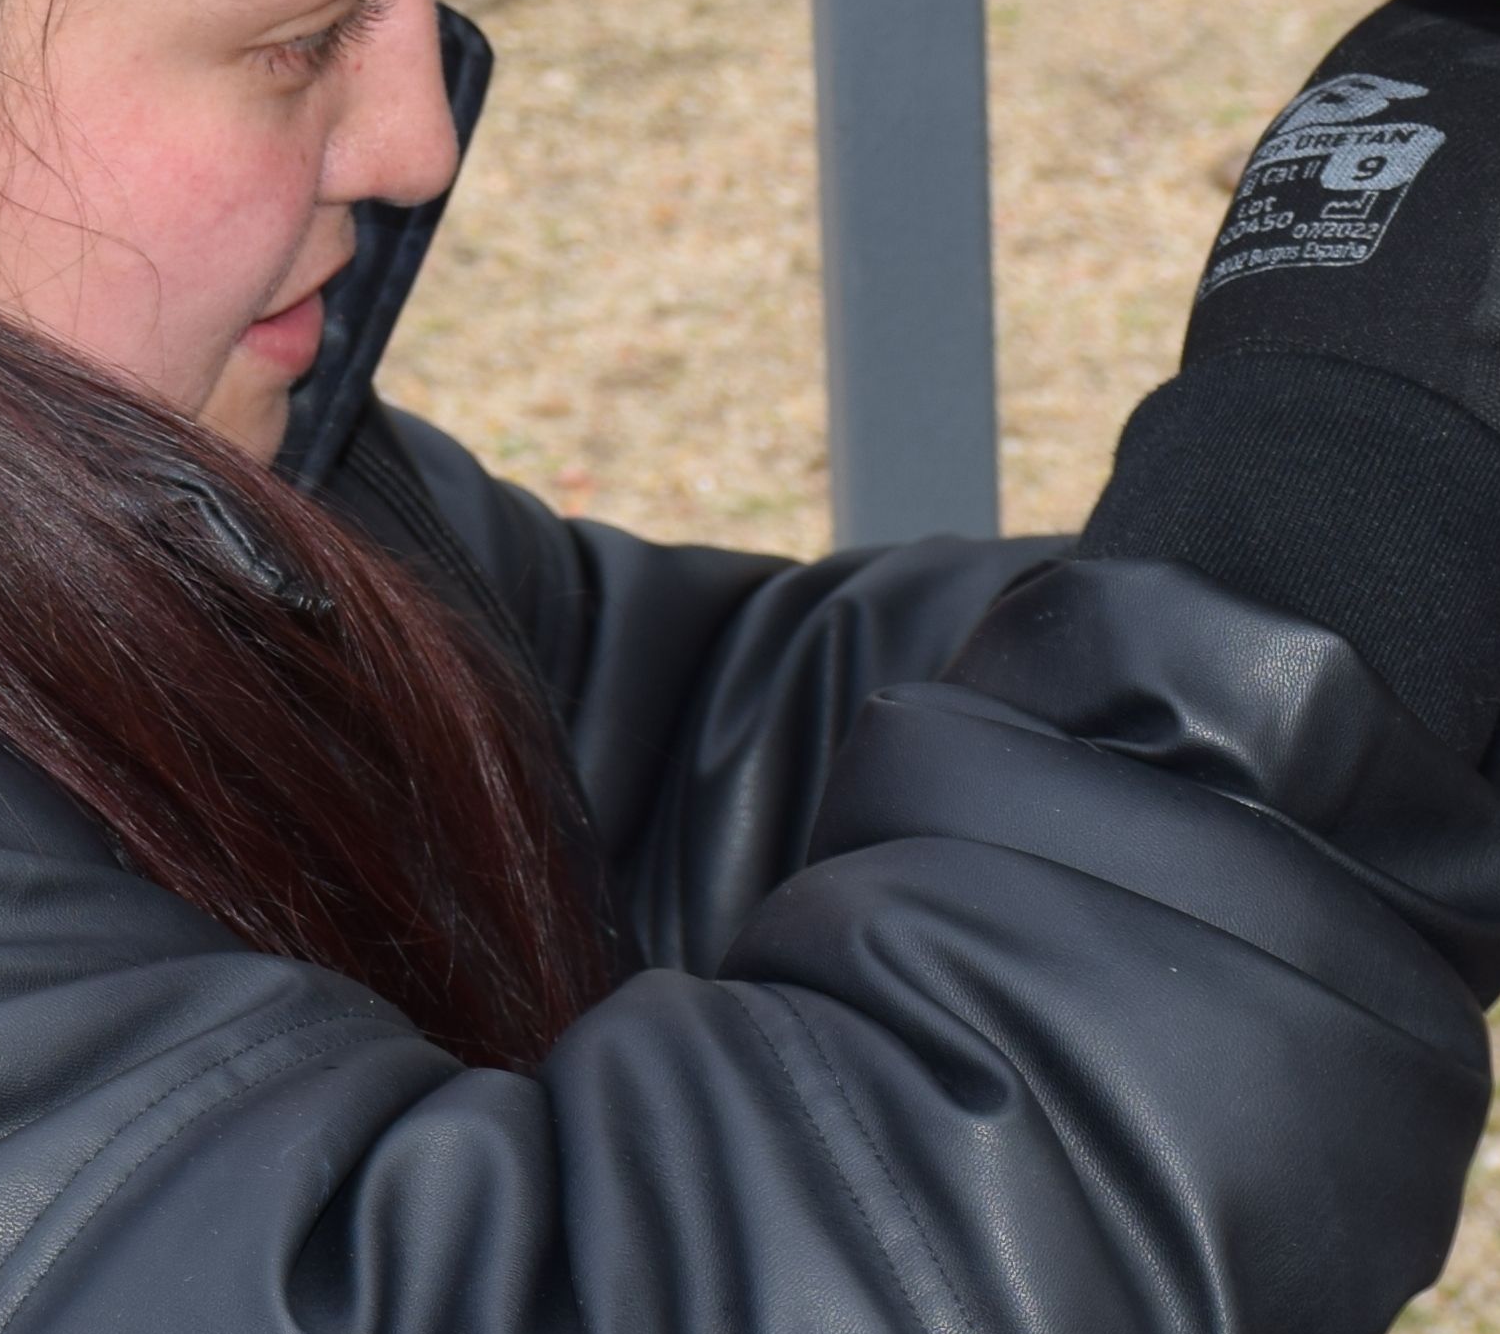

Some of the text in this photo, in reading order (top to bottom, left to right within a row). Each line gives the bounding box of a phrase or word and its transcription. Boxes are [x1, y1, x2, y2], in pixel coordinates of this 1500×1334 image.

[1295, 129, 1418, 150] URETAN
[1352, 156, 1388, 182] 9
[1293, 221, 1380, 240] 07/2022
